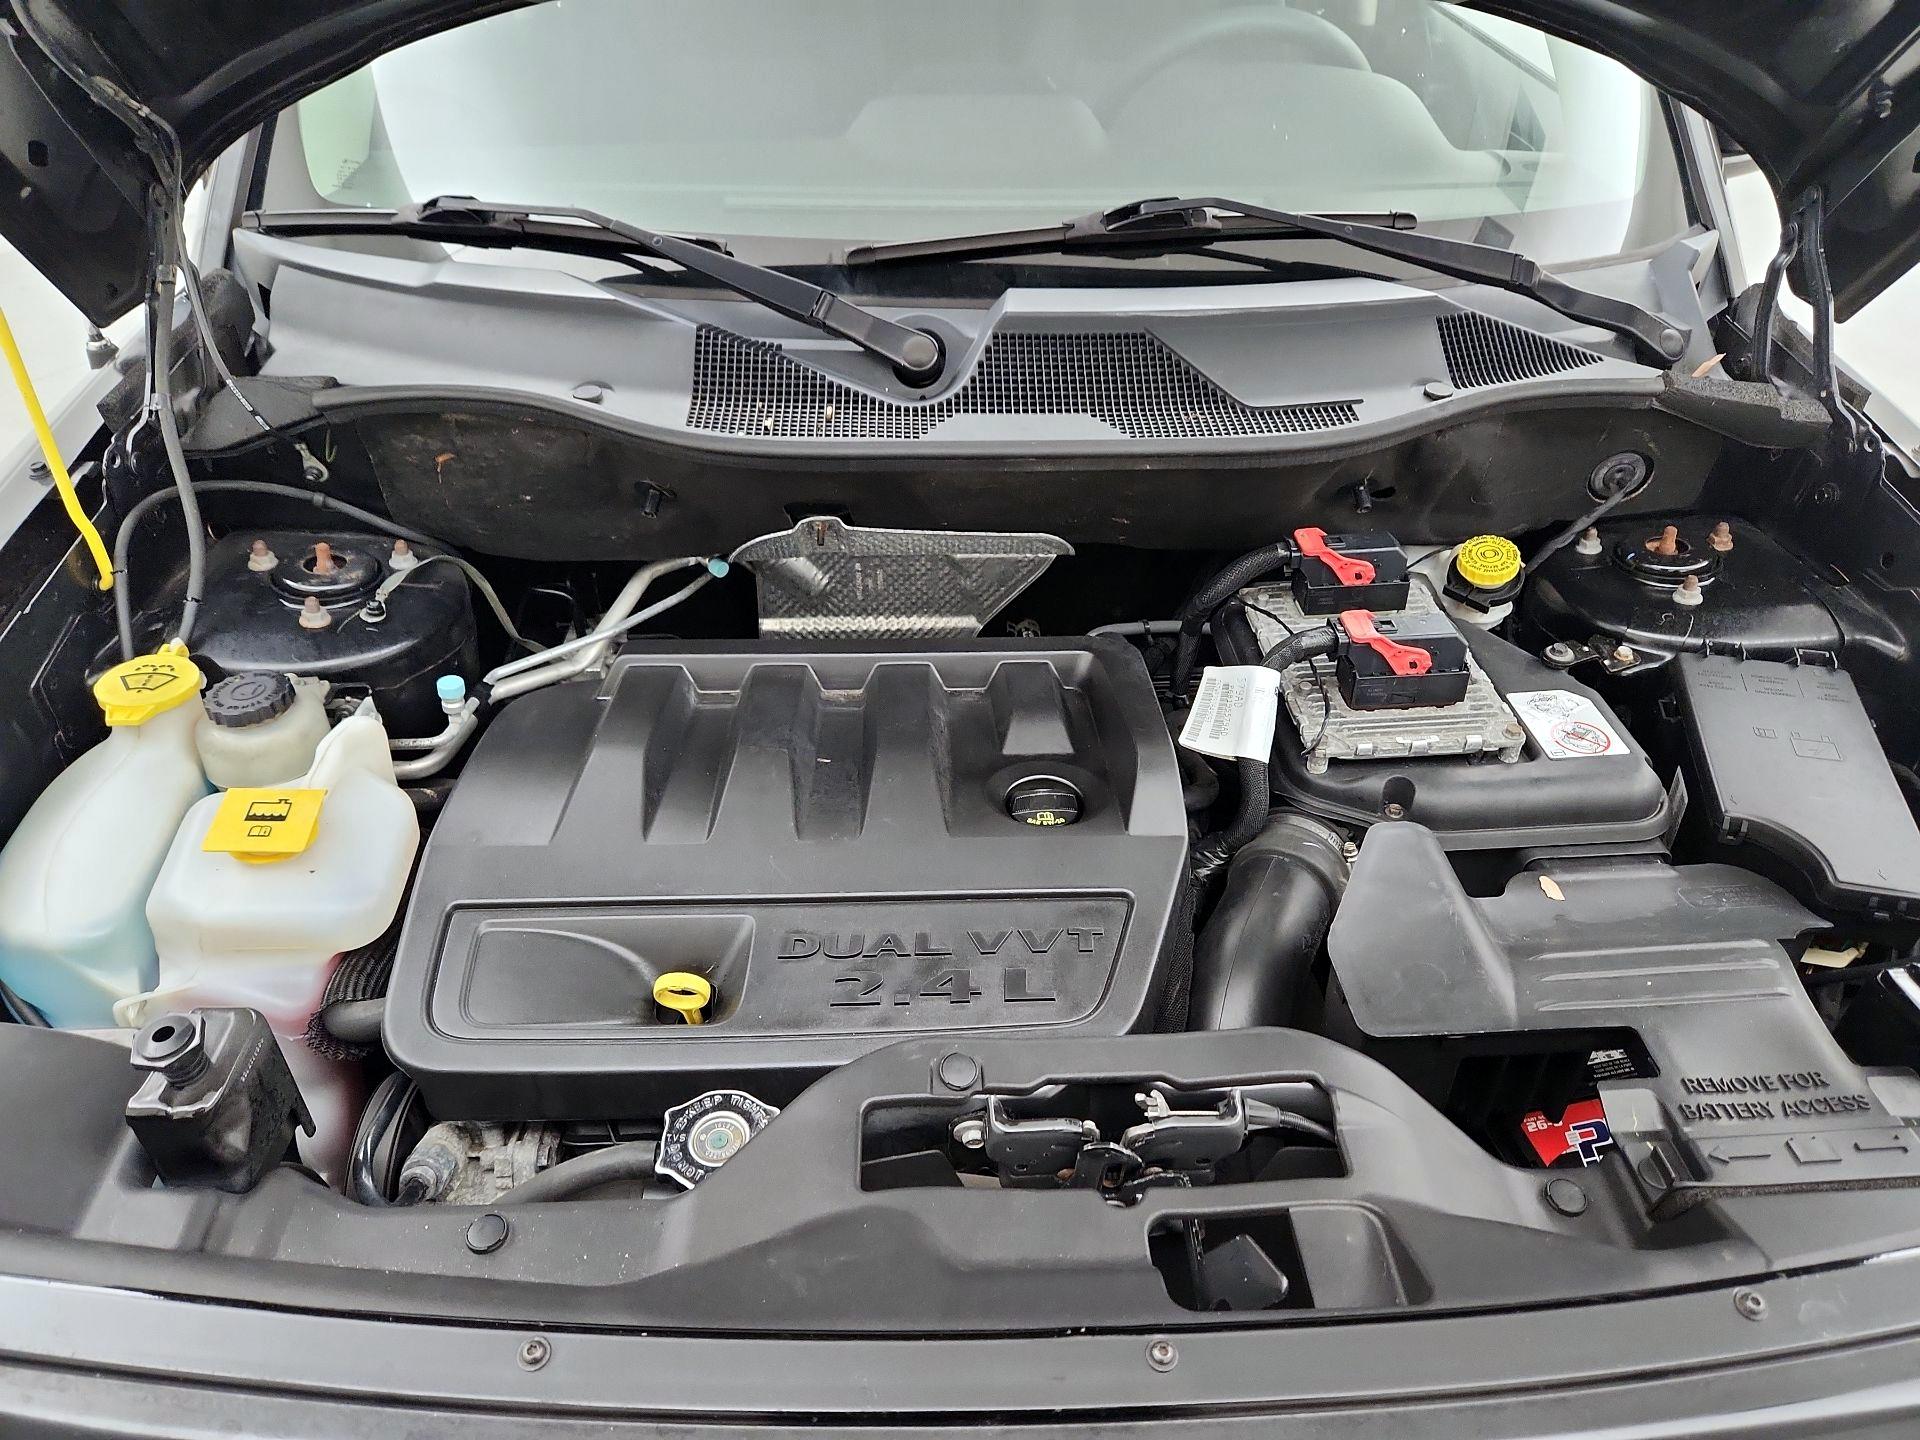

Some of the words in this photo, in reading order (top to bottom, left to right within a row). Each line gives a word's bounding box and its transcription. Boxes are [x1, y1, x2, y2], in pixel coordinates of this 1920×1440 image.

[777, 929, 952, 959] DUAL
[967, 927, 1104, 954] VVT
[1680, 1074, 1778, 1095] REMOVE
[1778, 1071, 1830, 1090] FOR
[1679, 1100, 1775, 1121] BATTERY
[1781, 1094, 1871, 1117] ACCESS
